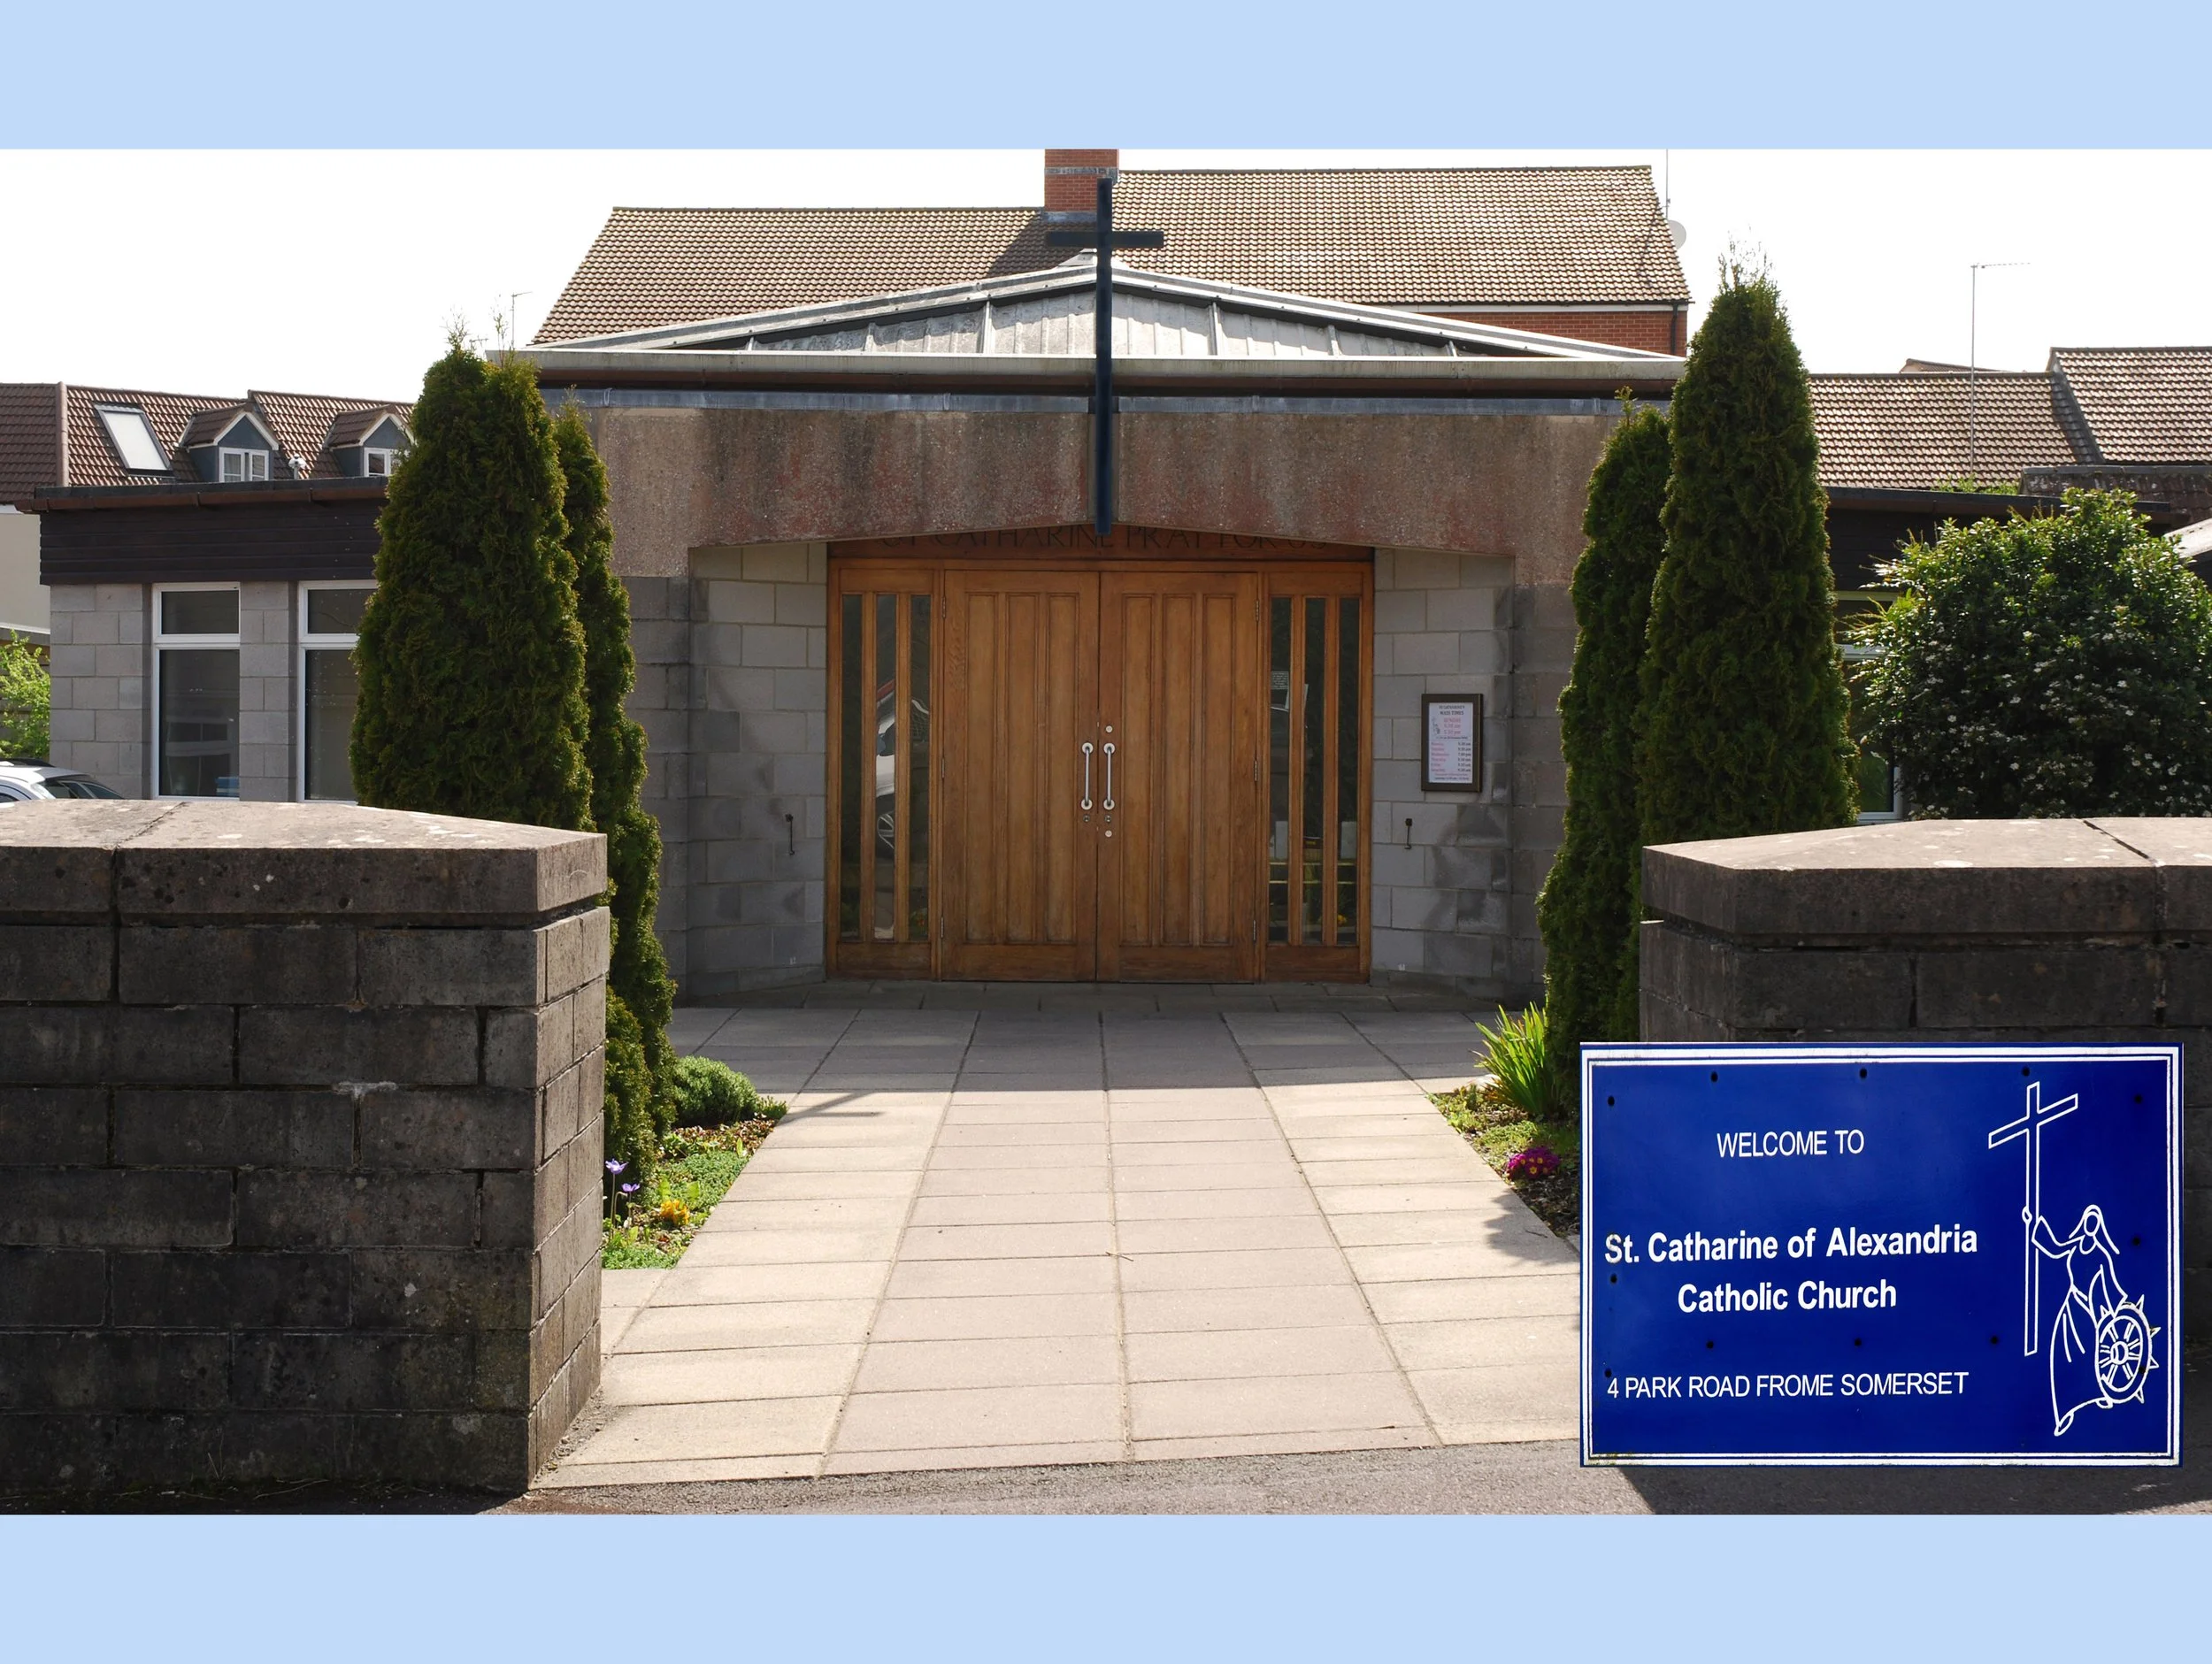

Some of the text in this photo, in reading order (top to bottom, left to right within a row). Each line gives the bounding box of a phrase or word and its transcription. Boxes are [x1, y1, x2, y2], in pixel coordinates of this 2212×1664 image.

[1717, 1129, 1865, 1158] WELCOME TO
[1604, 1223, 1978, 1264] St. Catharine of Alexandria
[1678, 1278, 1897, 1313] Catholic Church
[1607, 1371, 1970, 1399] 4 PARK ROAD FROME SOMERSET
